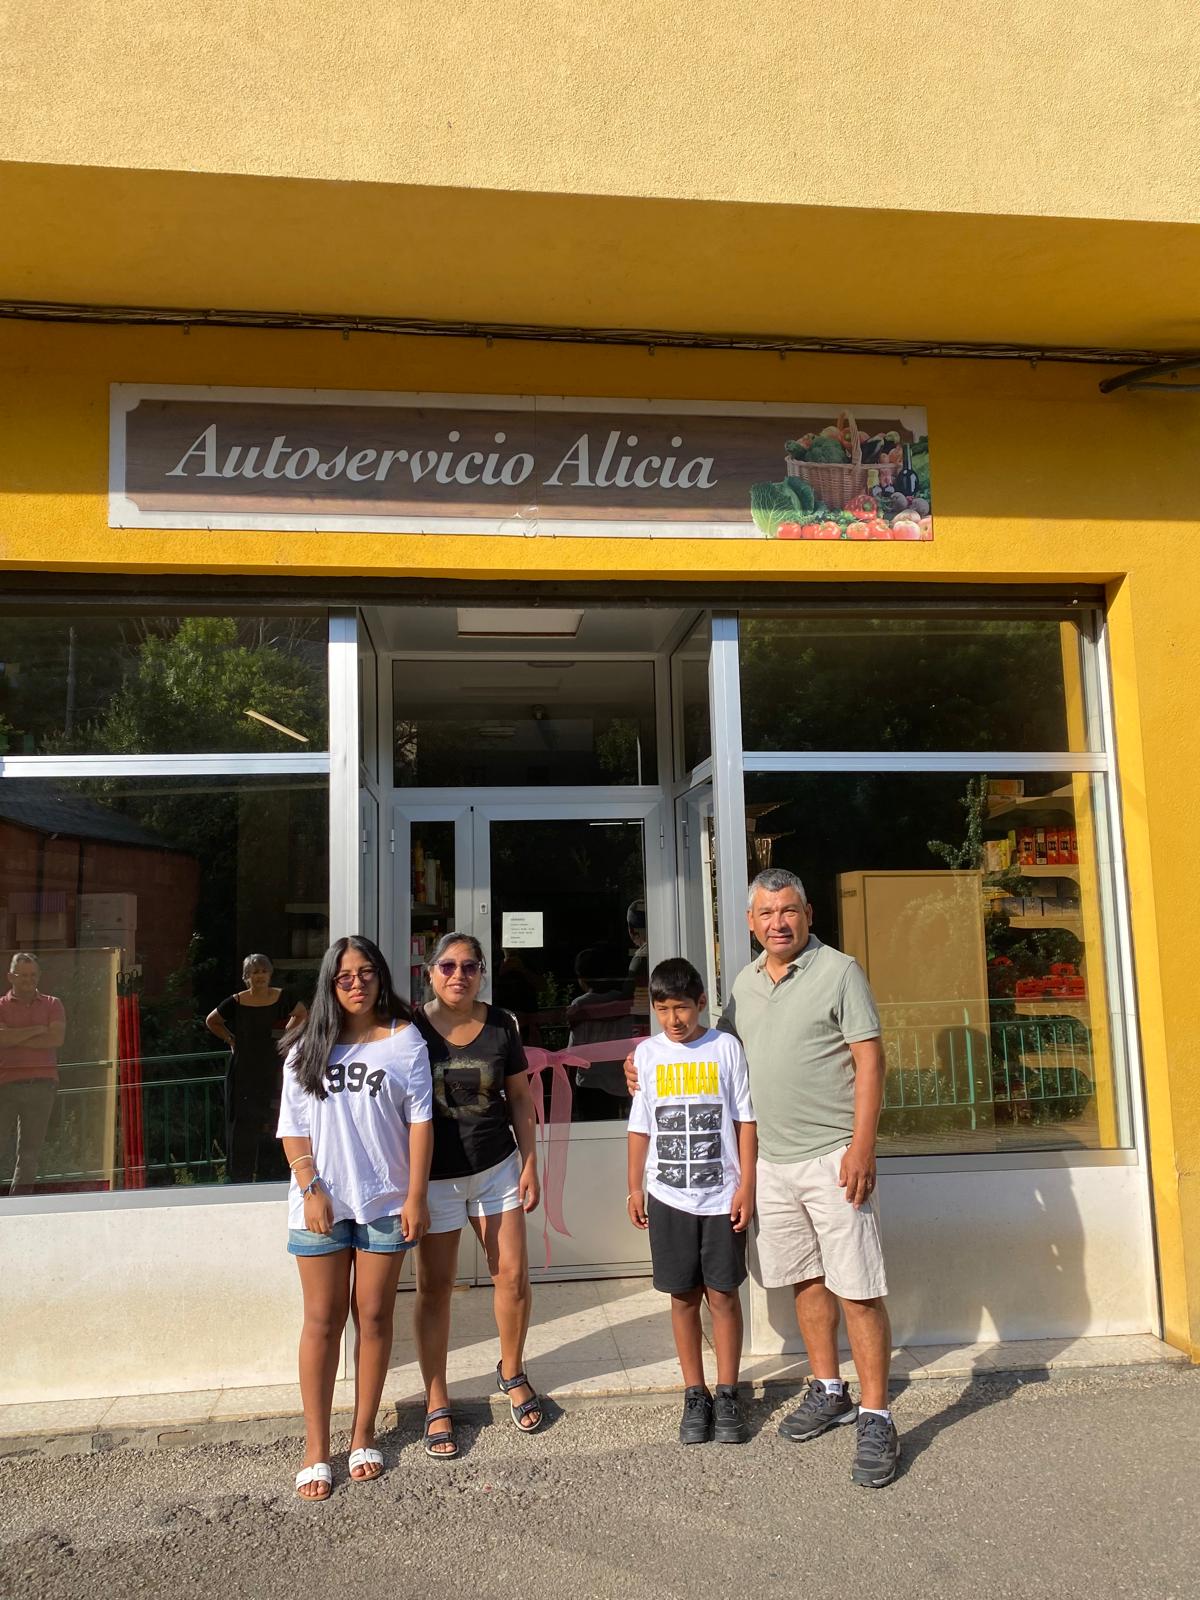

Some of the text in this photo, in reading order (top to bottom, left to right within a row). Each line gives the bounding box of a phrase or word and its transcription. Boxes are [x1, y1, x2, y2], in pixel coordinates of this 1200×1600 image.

[165, 424, 719, 490] Autoservicio Alicia
[320, 1062, 387, 1101] 994
[656, 1062, 719, 1098] BATMAN
